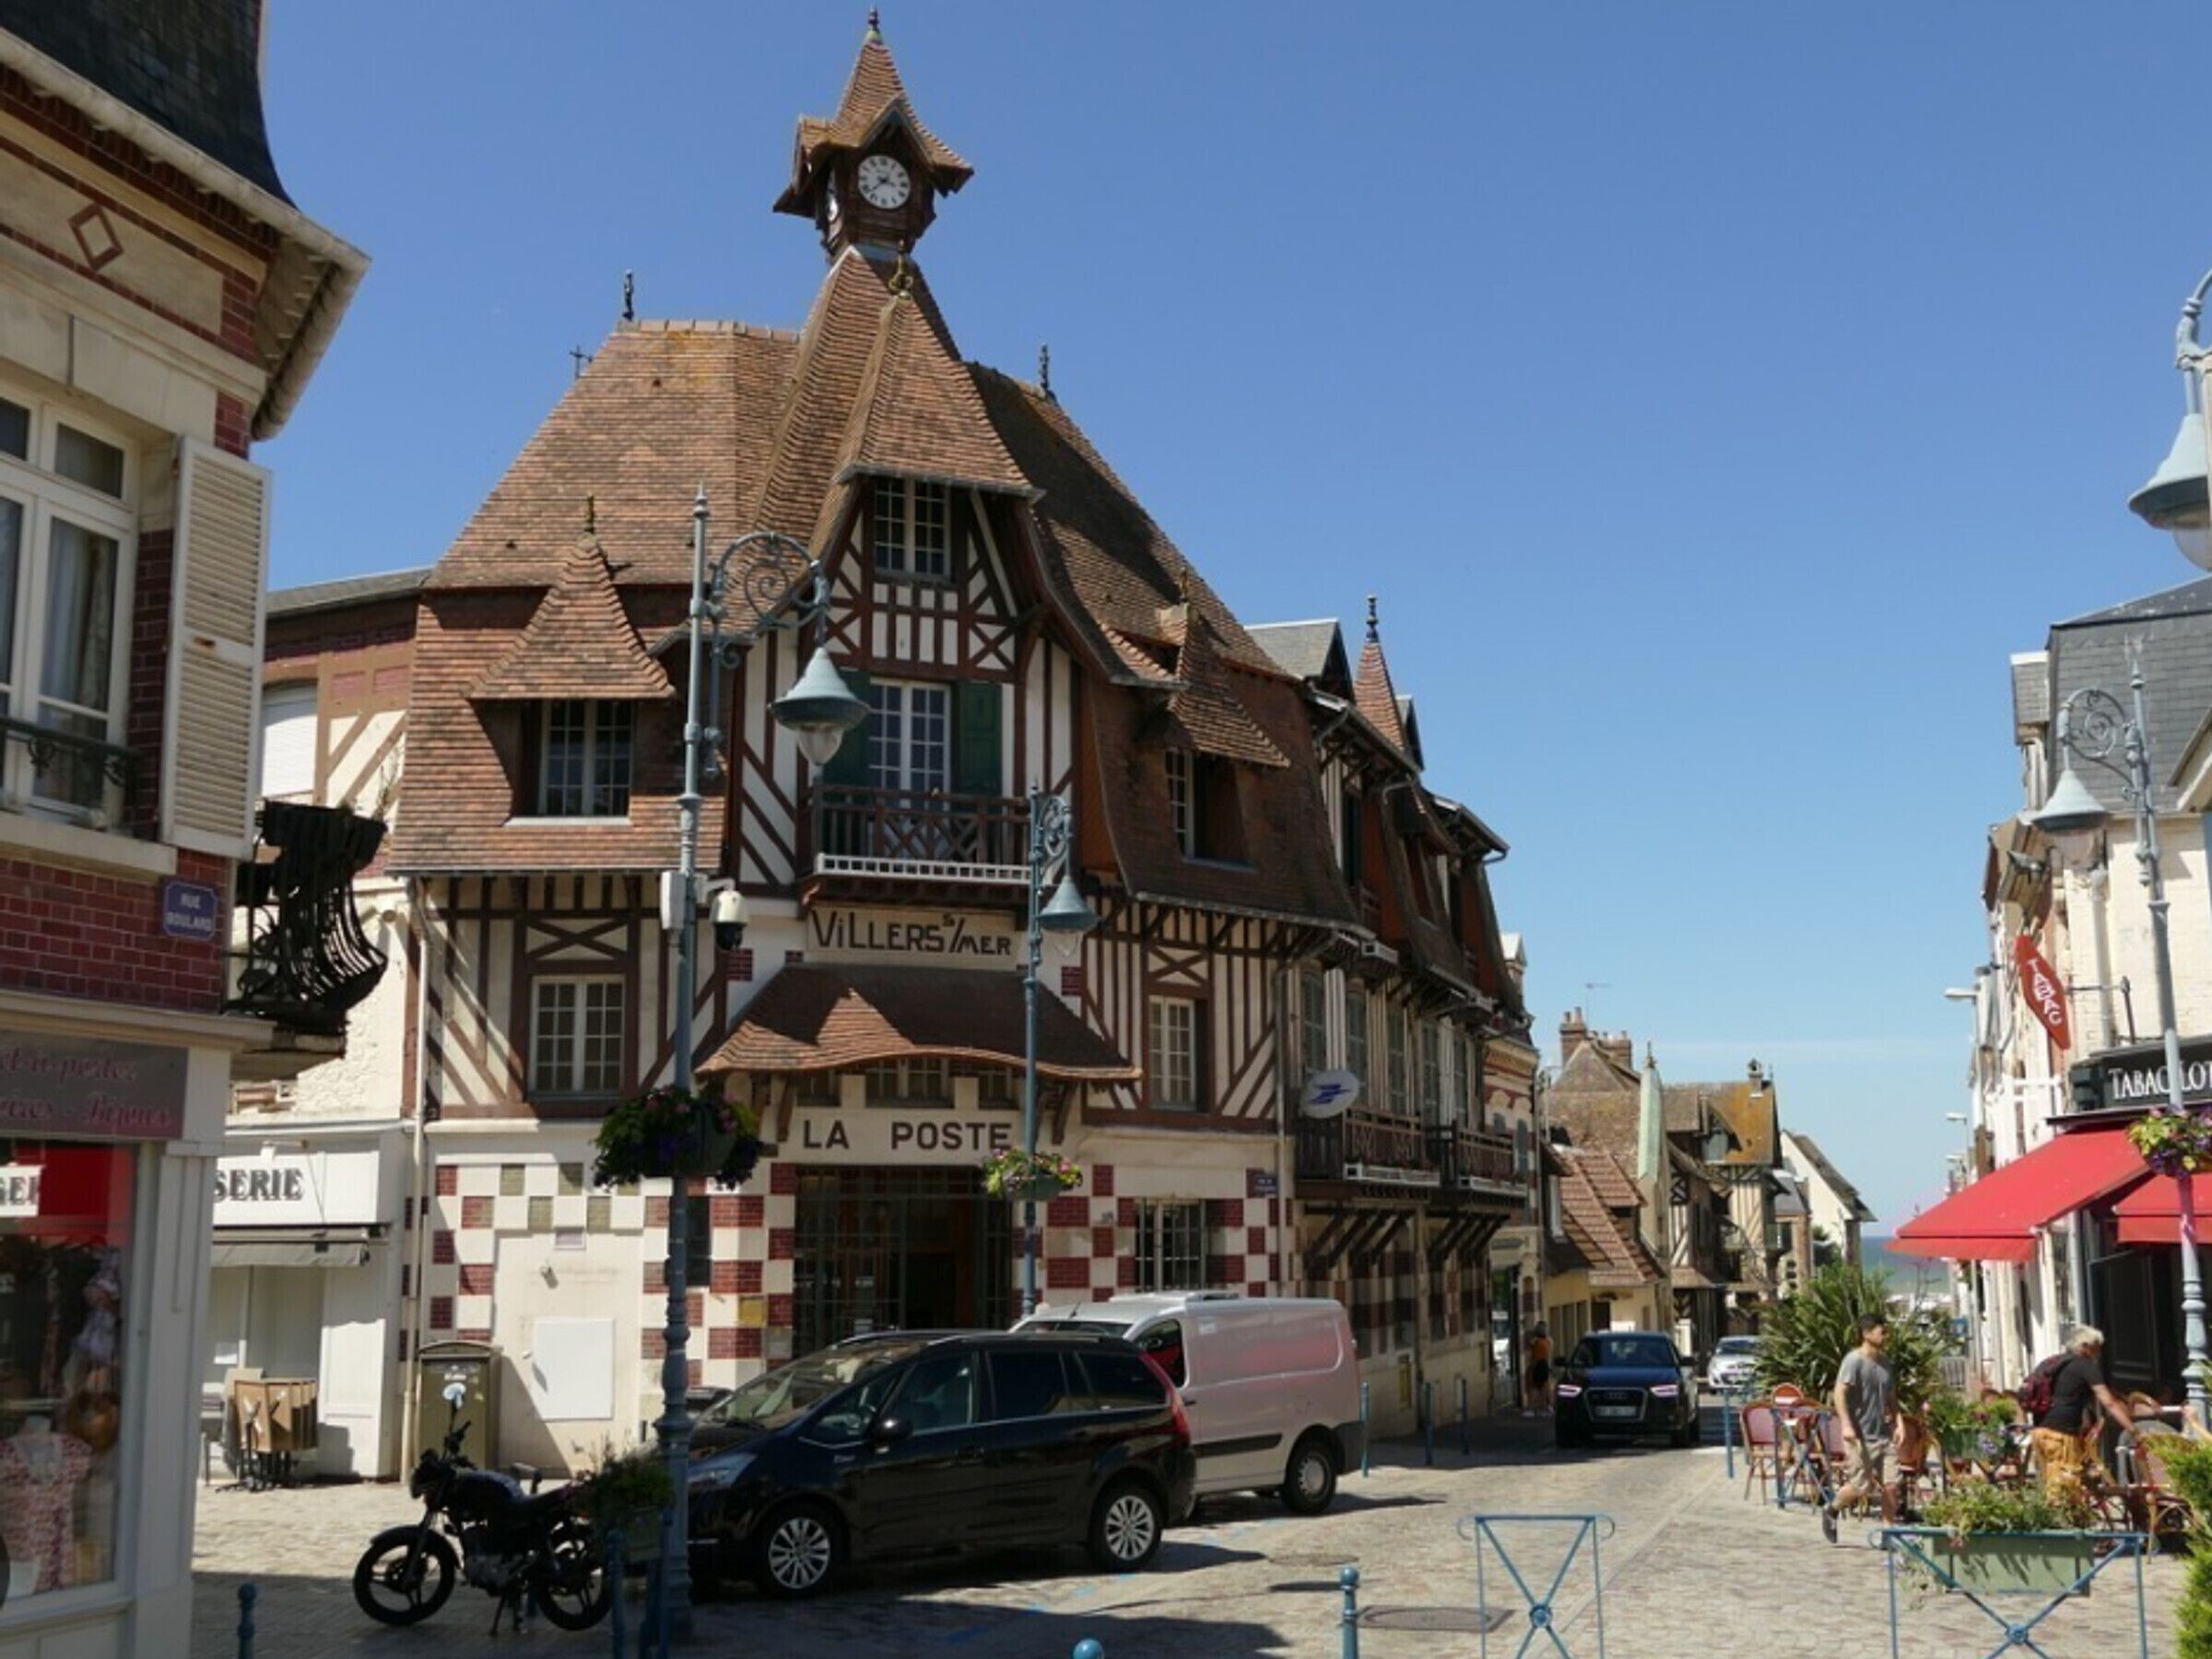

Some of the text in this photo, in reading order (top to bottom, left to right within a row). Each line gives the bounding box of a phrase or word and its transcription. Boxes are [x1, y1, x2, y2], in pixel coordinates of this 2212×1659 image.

[181, 893, 201, 910] RUE
[2028, 958, 2063, 1027] TABAC
[2108, 1064, 2171, 1100] TABAC
[804, 1120, 1013, 1150] LA POSTE
